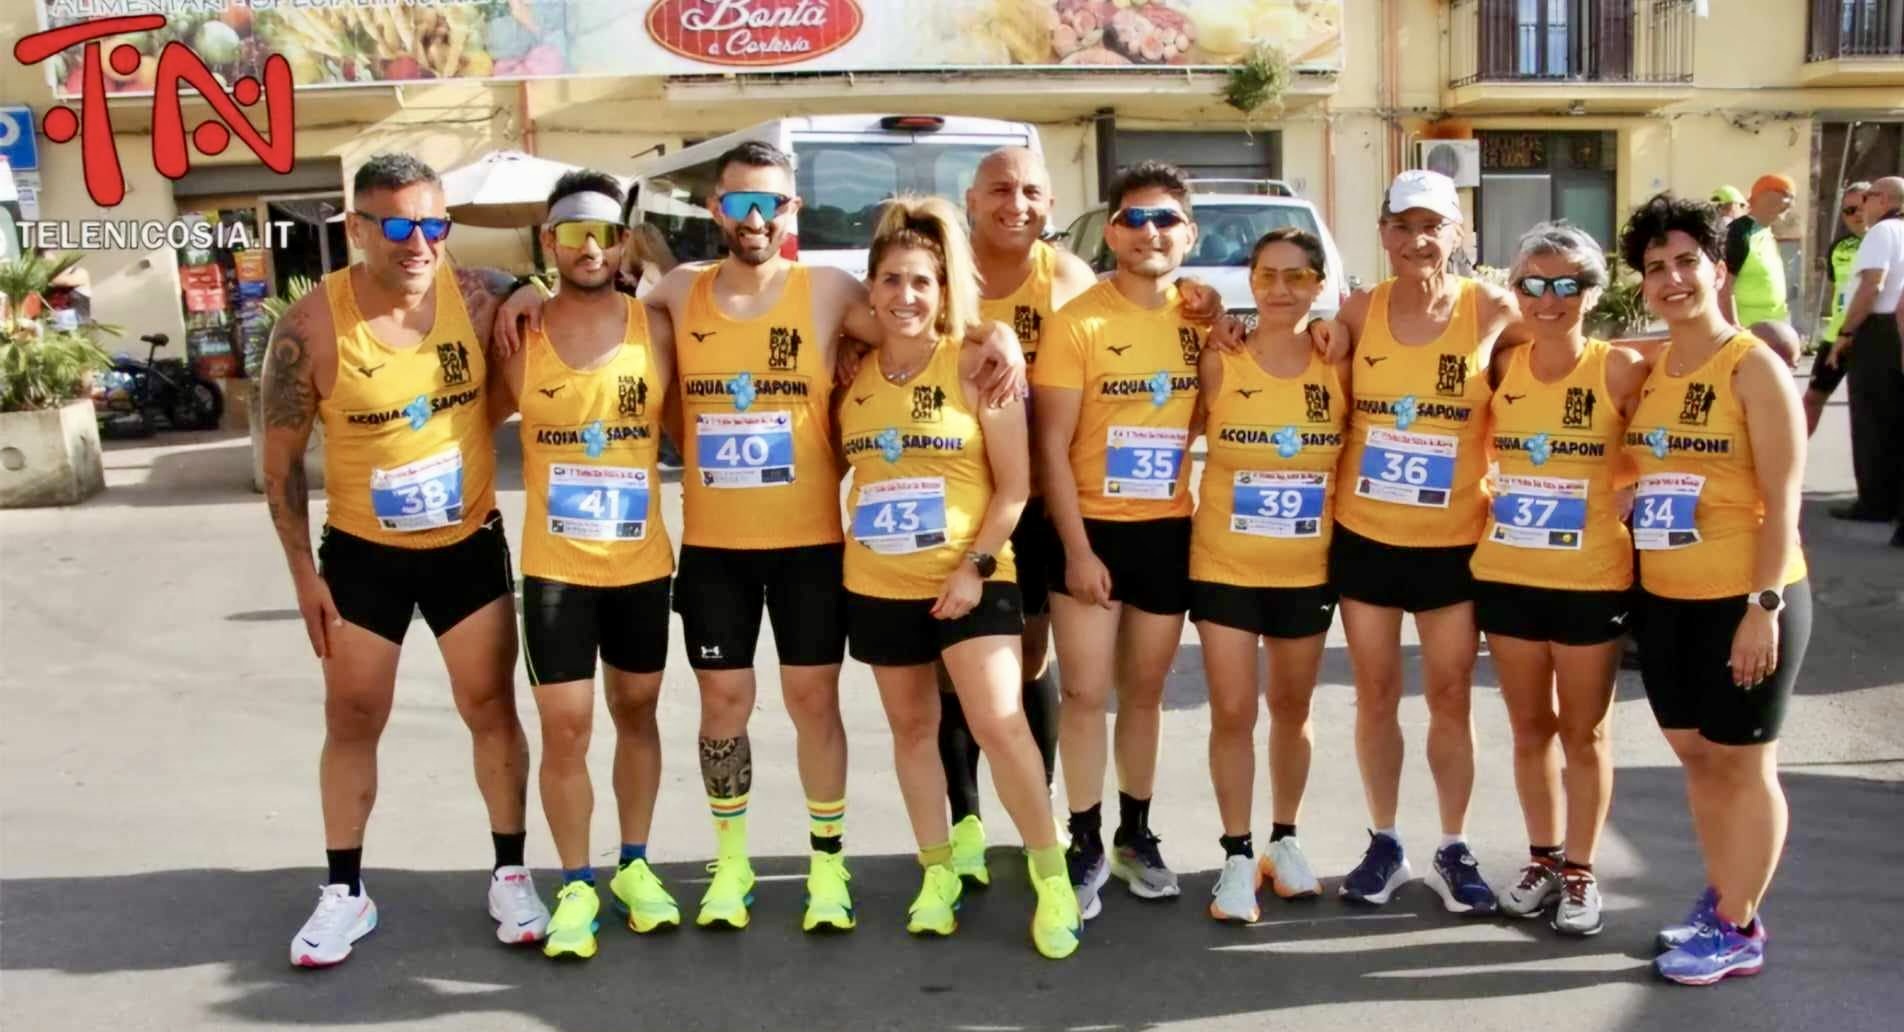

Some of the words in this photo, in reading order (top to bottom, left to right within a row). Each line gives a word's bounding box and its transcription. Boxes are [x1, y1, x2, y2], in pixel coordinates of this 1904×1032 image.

[715, 435, 769, 466] 40
[902, 434, 963, 450] SAPONE
[1219, 428, 1269, 444] ACQUA
[1131, 449, 1174, 479] 35
[1380, 452, 1429, 485] 36
[392, 479, 449, 514] 38
[578, 489, 620, 519] 41
[1257, 490, 1303, 518] 39
[873, 501, 920, 533] 43
[1513, 497, 1559, 527] 37
[1640, 497, 1675, 528] 34
